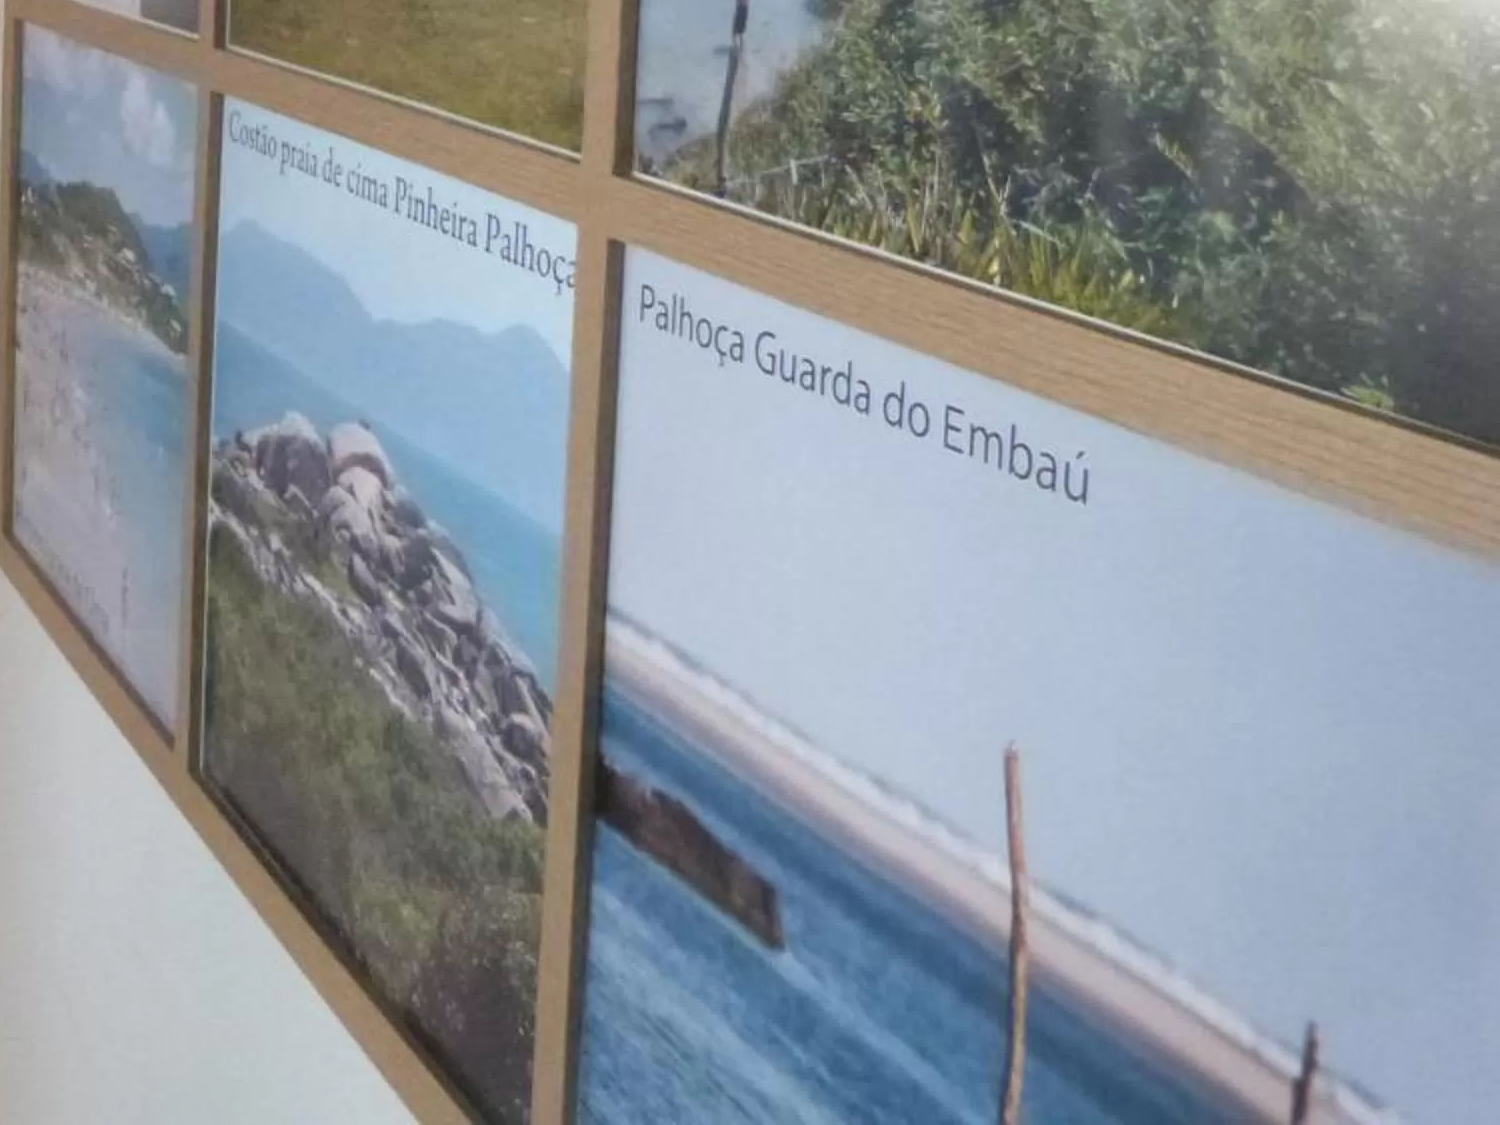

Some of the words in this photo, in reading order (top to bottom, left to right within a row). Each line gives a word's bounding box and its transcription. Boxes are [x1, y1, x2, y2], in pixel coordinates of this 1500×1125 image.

[228, 109, 278, 159] Costão
[280, 139, 318, 176] praia
[322, 146, 342, 189] de
[347, 161, 389, 209] cima
[394, 176, 478, 248] Pinheira
[640, 284, 745, 368] Palhoça
[755, 330, 871, 416] Guarda
[883, 380, 930, 438] do
[943, 405, 1090, 505] Embaú
